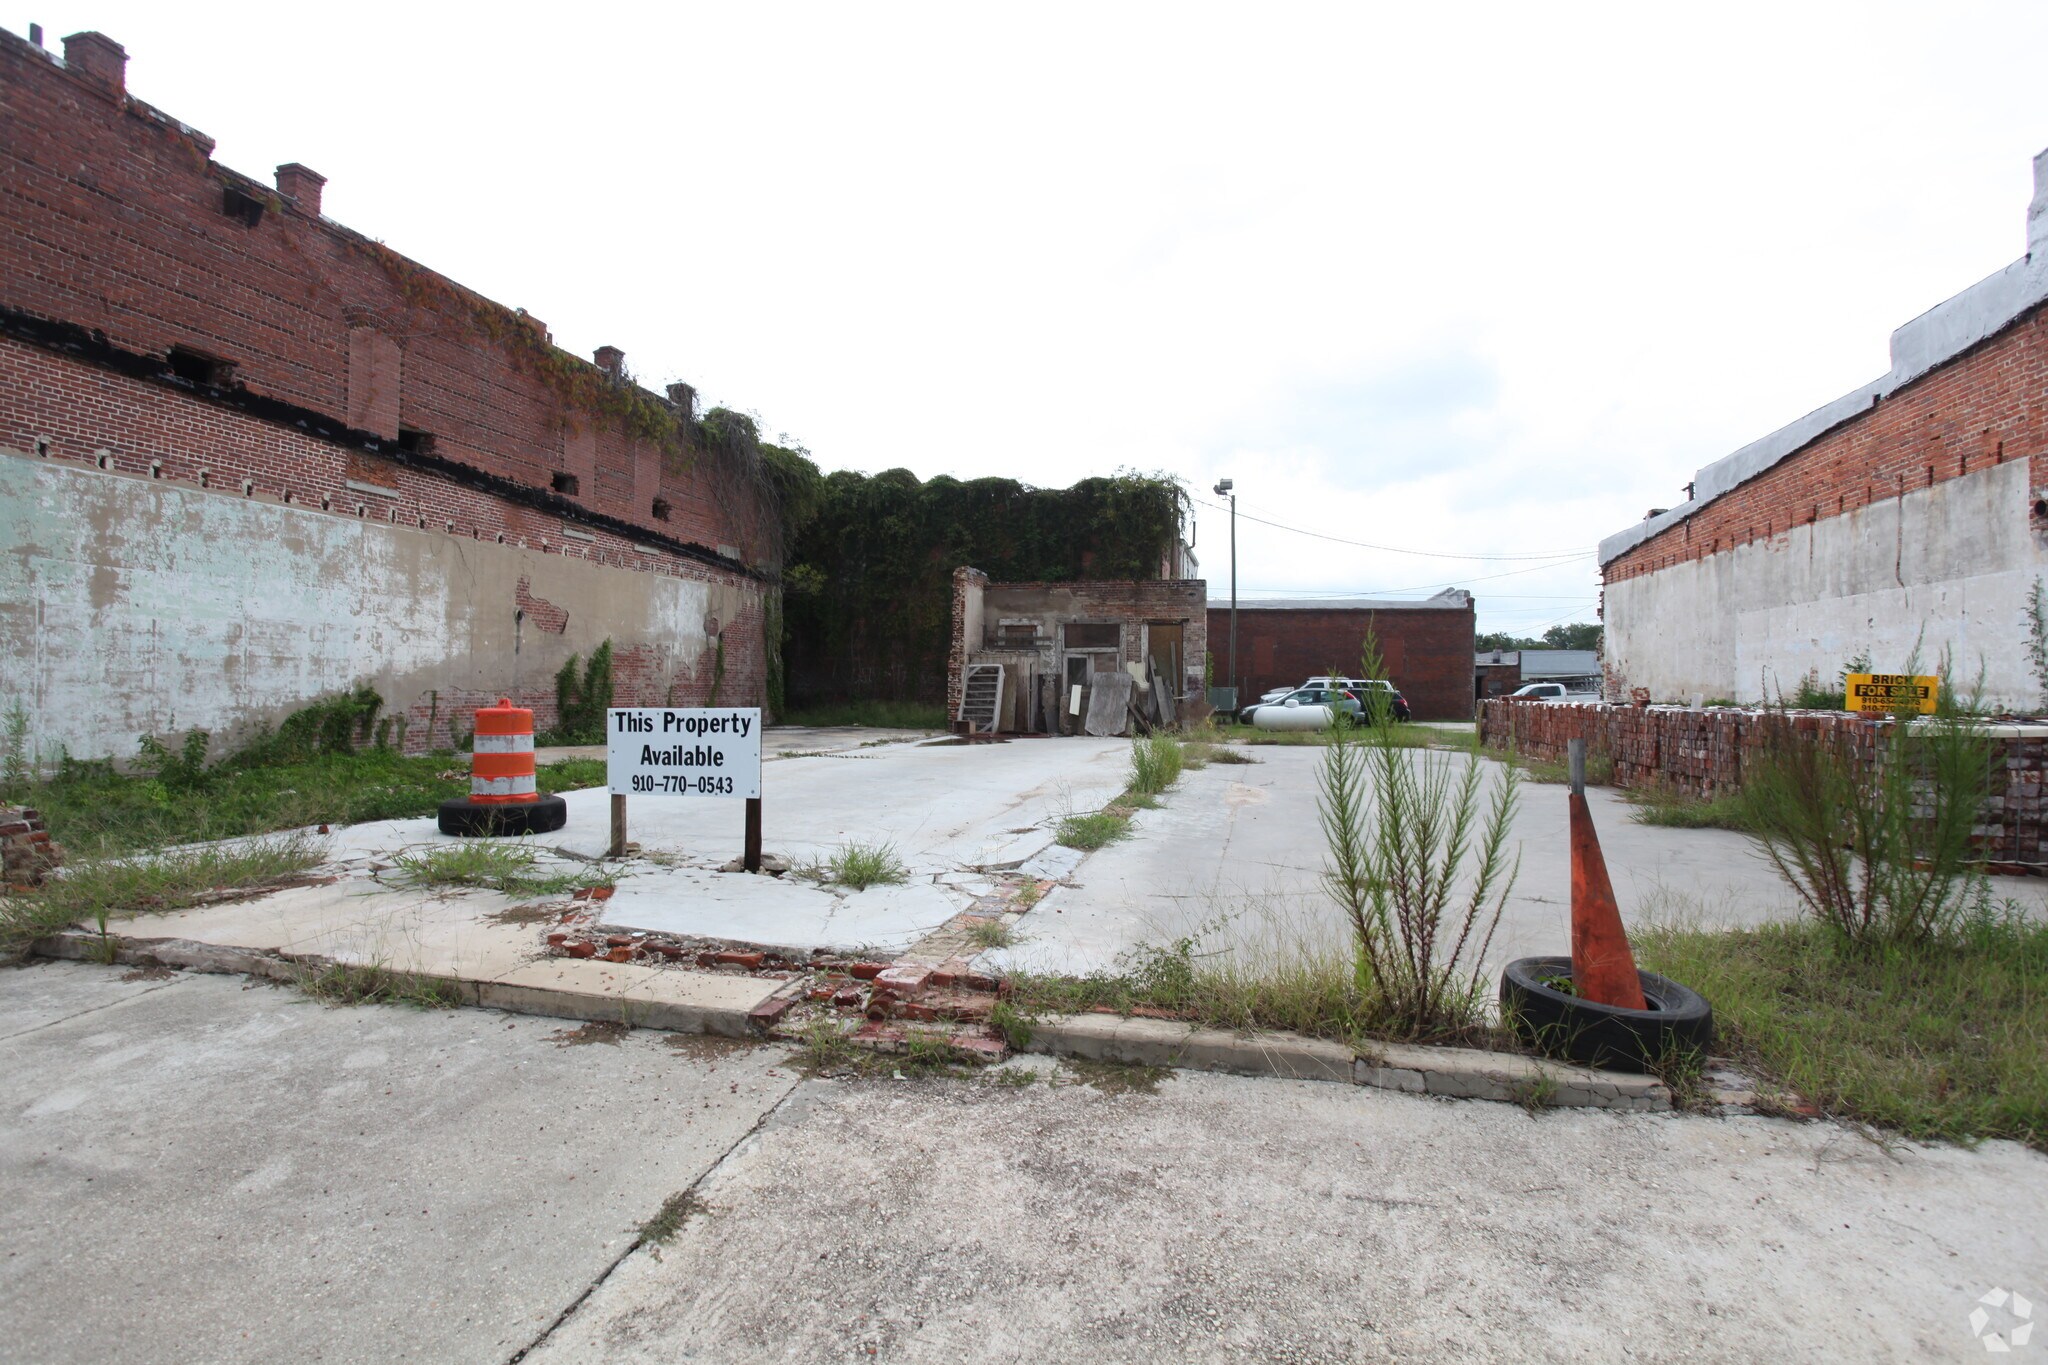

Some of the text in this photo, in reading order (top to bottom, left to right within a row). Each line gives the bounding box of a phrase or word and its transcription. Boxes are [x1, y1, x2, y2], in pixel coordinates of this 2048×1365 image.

[1872, 675, 1914, 684] BRICK
[1859, 686, 1925, 698] FOR SALE
[615, 712, 751, 738] This Property
[640, 744, 724, 767] Available
[632, 775, 733, 794] 910-770-0543
